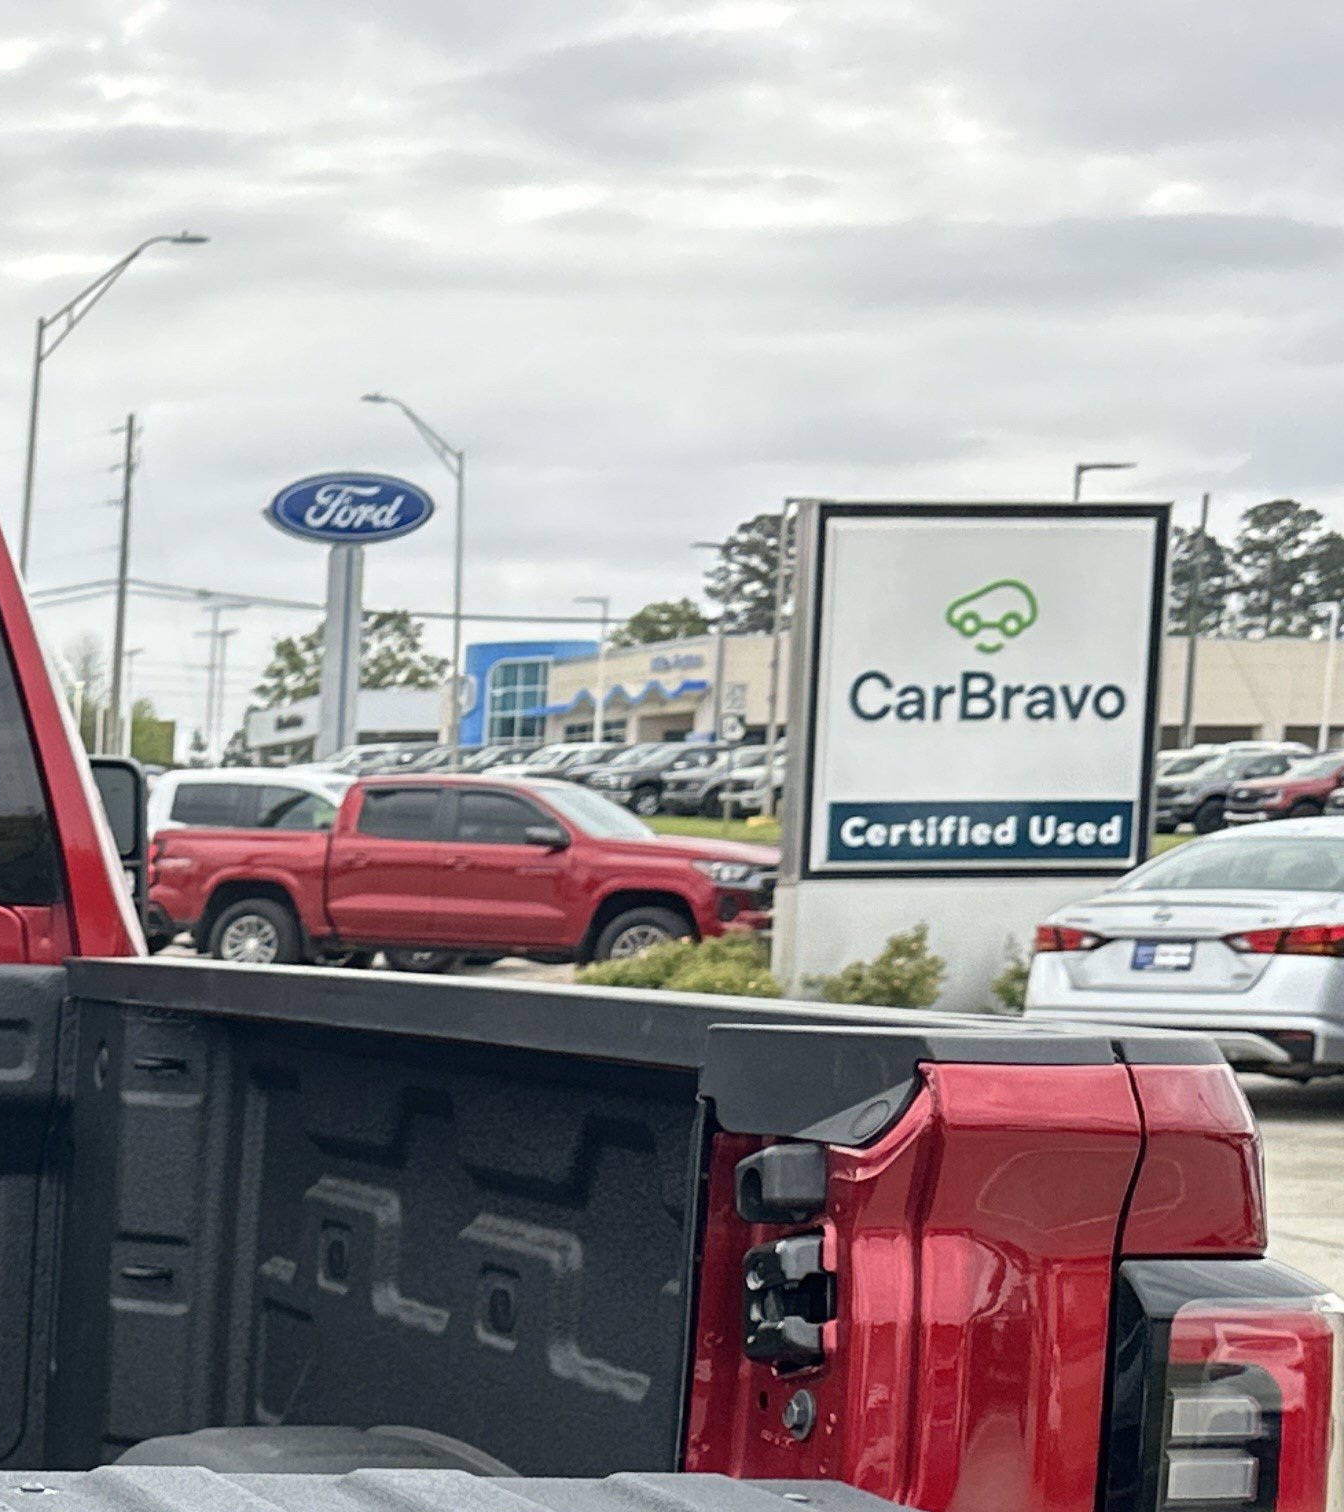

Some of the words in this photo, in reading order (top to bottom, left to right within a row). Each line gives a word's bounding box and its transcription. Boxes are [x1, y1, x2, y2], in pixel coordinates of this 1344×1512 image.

[304, 484, 405, 529] Ford
[849, 670, 1126, 722] CarBravo
[840, 815, 1018, 847] Certified
[1028, 815, 1123, 846] Used
